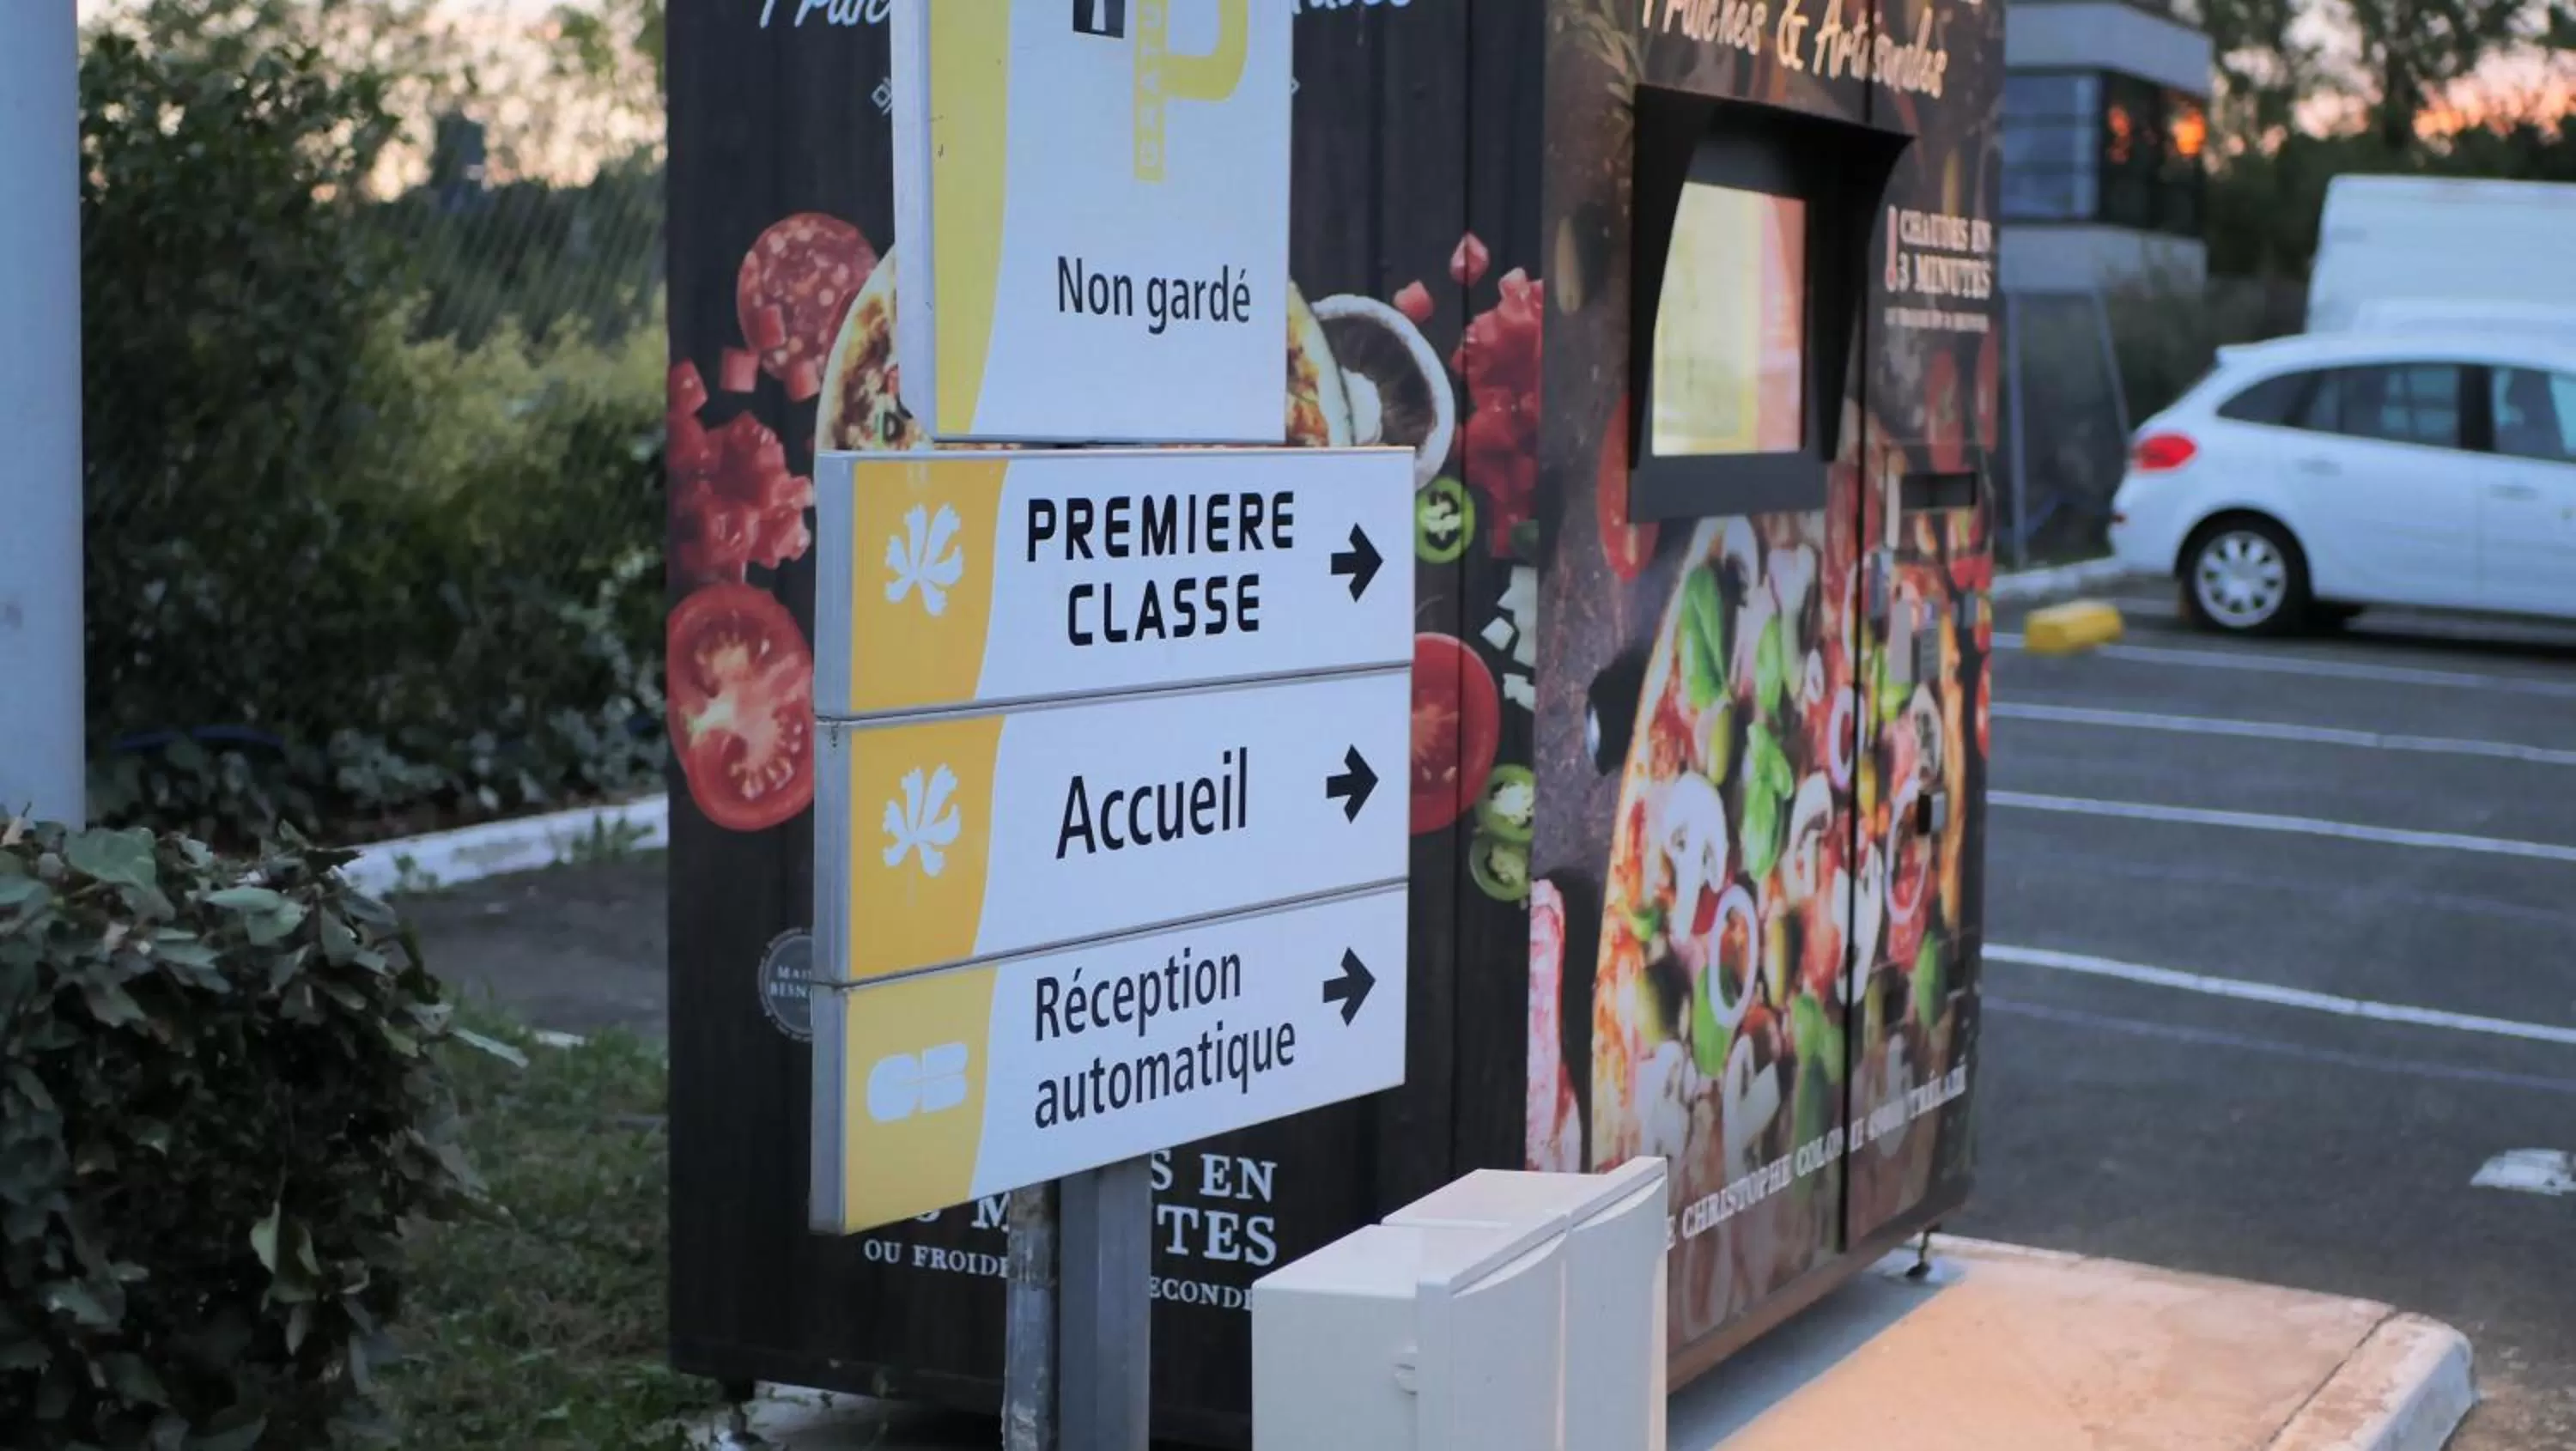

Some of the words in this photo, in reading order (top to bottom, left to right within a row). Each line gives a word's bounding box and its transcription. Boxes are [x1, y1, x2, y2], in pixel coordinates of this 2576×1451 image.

[1057, 255, 1133, 317] Non
[1147, 264, 1250, 335] gardé
[1026, 490, 1295, 562] PREMIERE
[1066, 574, 1261, 647] CLASSE
[1055, 747, 1248, 859] Accueil
[1036, 947, 1241, 1041] Réception
[1035, 1020, 1295, 1129] automatique
[1199, 1152, 1278, 1203] EN
[864, 1239, 902, 1264] OU
